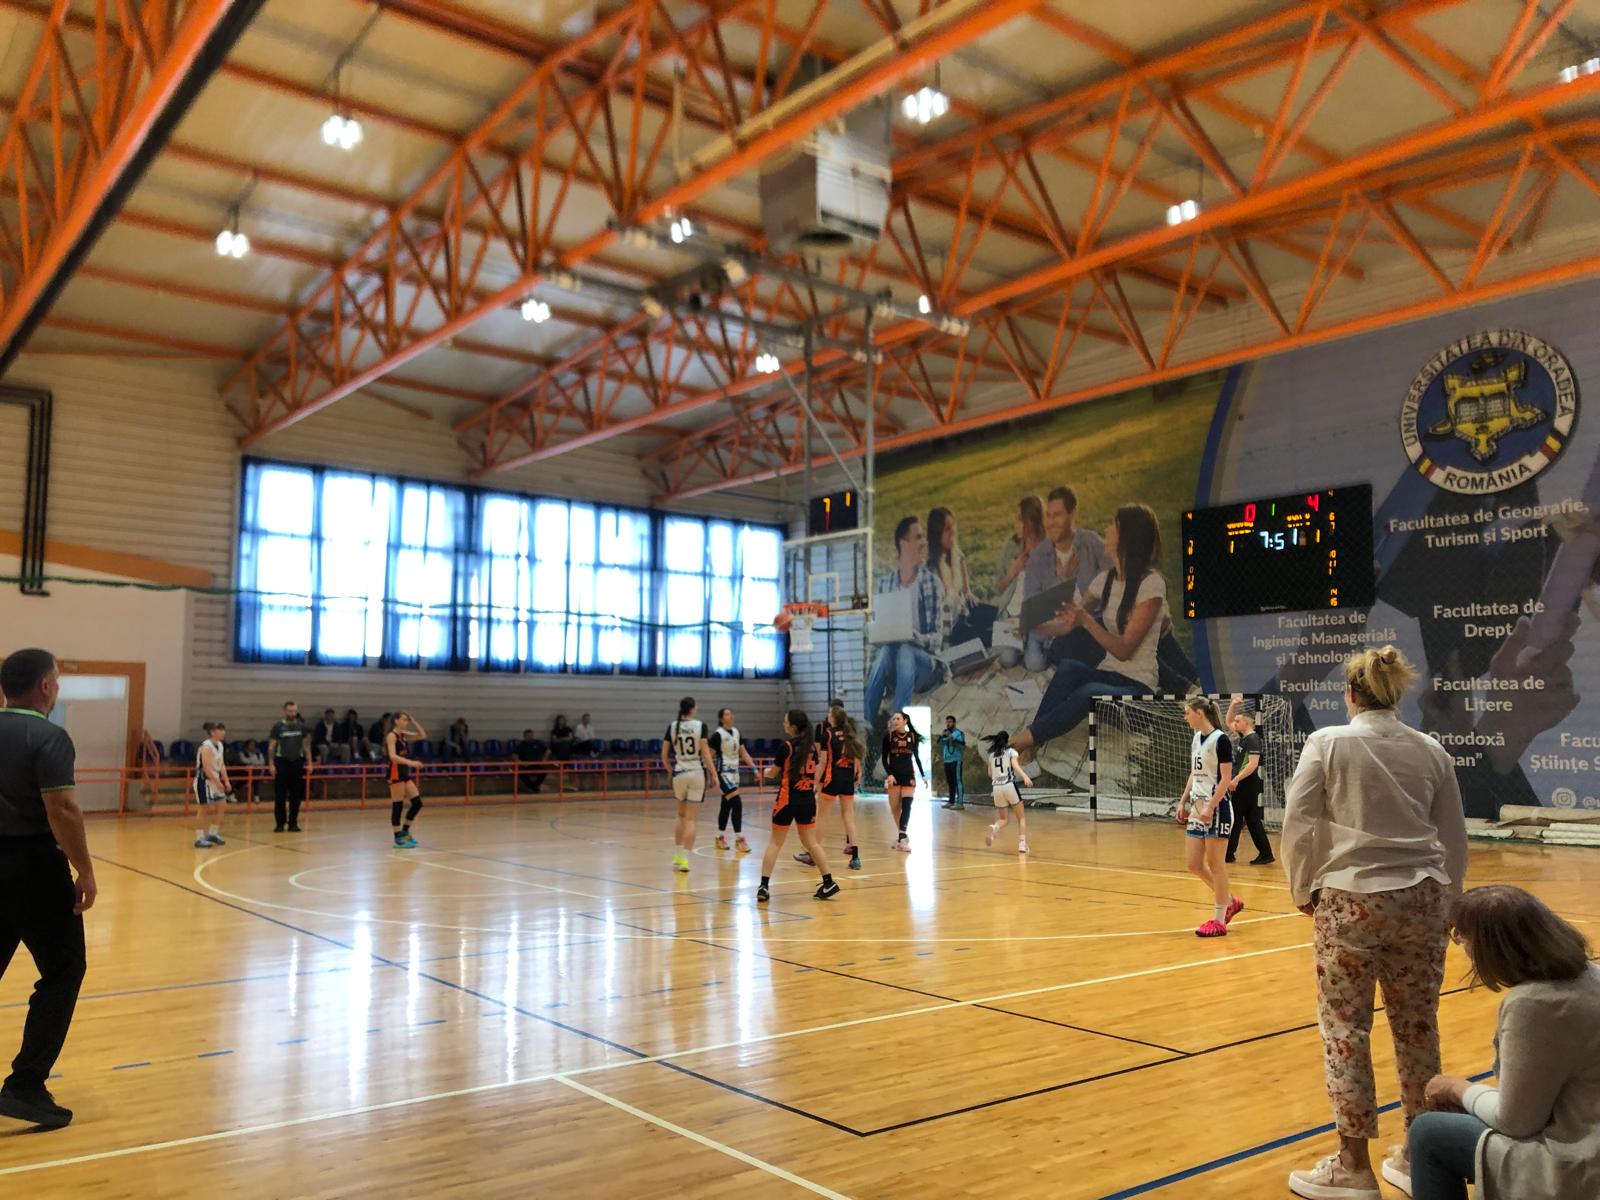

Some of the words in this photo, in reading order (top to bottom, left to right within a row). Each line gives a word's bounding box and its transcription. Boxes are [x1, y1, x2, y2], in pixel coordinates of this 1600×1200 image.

[1534, 345, 1574, 418] ORADEA
[1244, 503, 1256, 522] 0
[1307, 494, 1319, 512] 4
[1389, 514, 1470, 533] Facultatea
[1473, 508, 1494, 522] de
[1498, 497, 1590, 519] Geografie,
[1425, 532, 1480, 549] Turism
[1500, 523, 1549, 543] Sport
[1434, 602, 1519, 619] Facultatea
[1524, 598, 1545, 614] de
[1278, 612, 1345, 628] Facultatea
[1349, 611, 1366, 624] de
[1464, 623, 1514, 638] Drept
[1253, 634, 1309, 650] Inginerie
[1311, 628, 1397, 647] Managerială
[1433, 677, 1519, 691] Facultatea
[1523, 675, 1545, 690] de
[1309, 698, 1339, 711] Arte
[1464, 697, 1513, 712] Litere
[1268, 730, 1307, 744] Facult
[678, 736, 696, 756] 13
[994, 758, 1004, 774] 4
[1194, 757, 1202, 770] 15
[1220, 822, 1230, 835] 15
